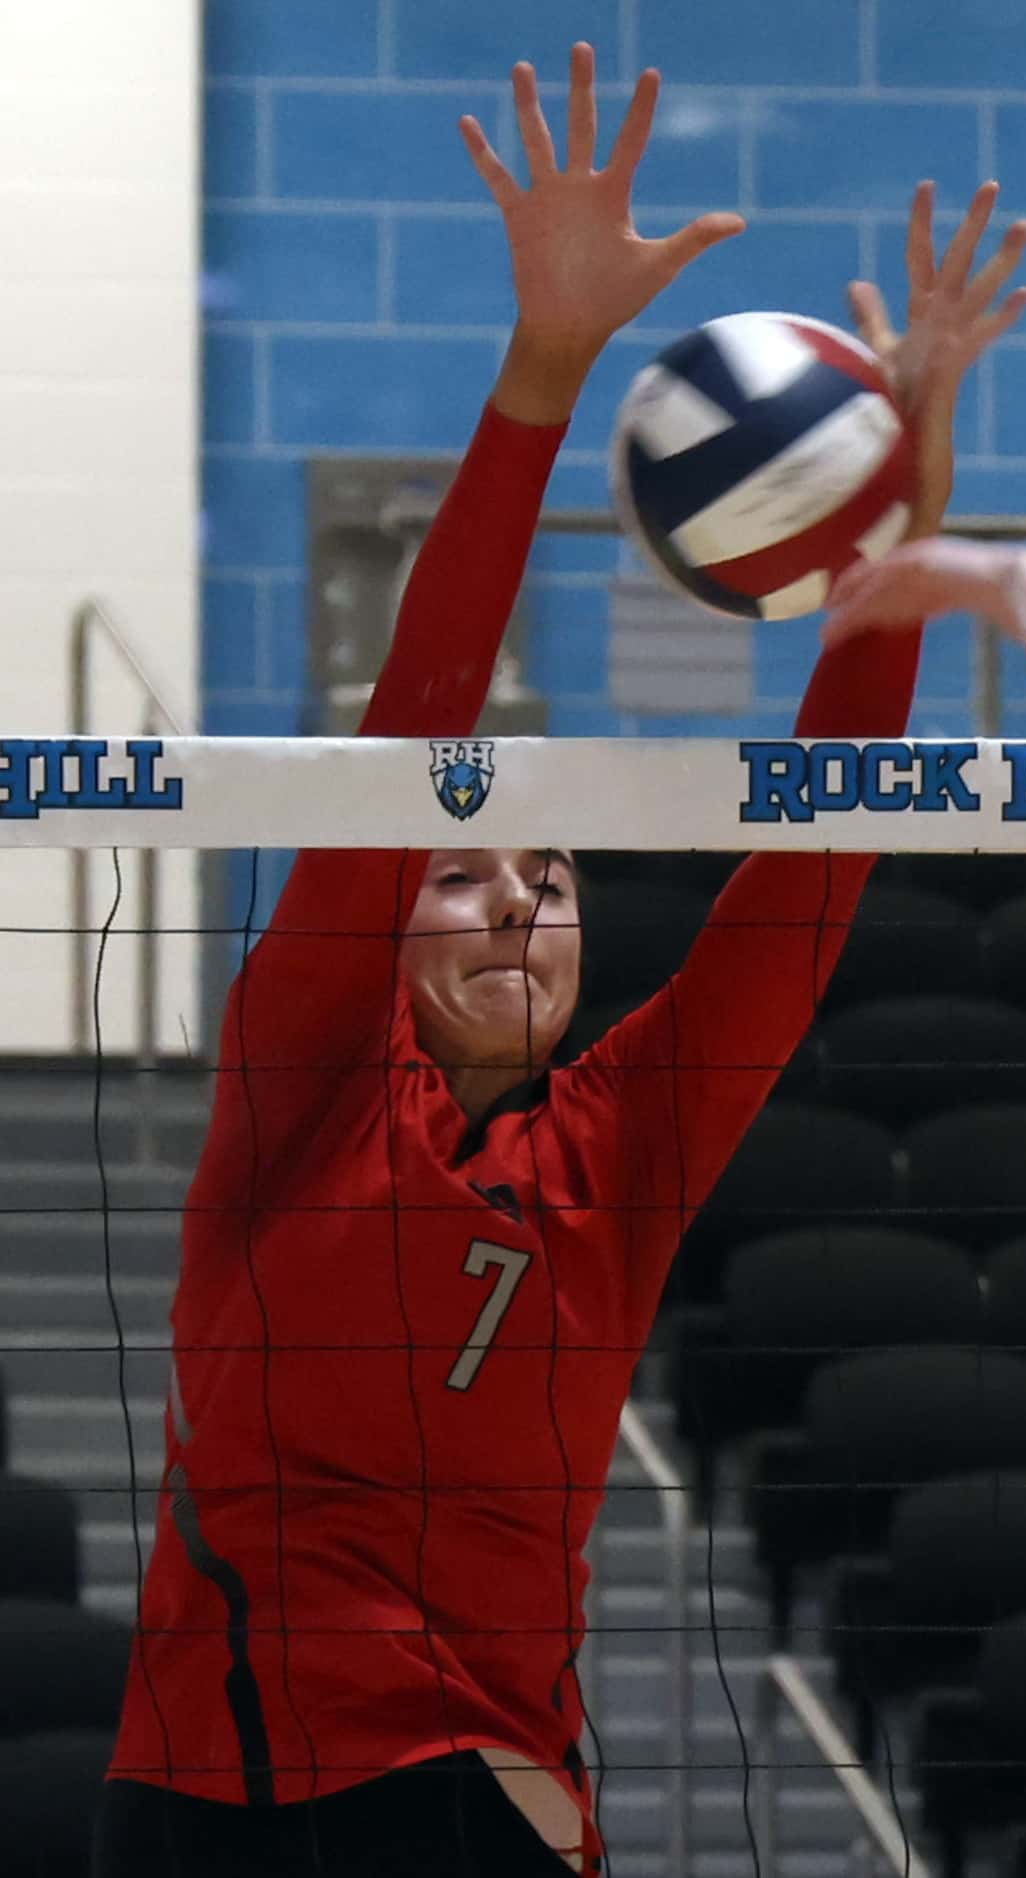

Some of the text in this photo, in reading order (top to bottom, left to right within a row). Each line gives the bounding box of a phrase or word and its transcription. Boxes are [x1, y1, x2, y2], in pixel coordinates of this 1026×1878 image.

[0, 740, 182, 819] HILL
[429, 741, 495, 776] RH
[740, 742, 981, 823] ROCK
[445, 1237, 534, 1392] 7
